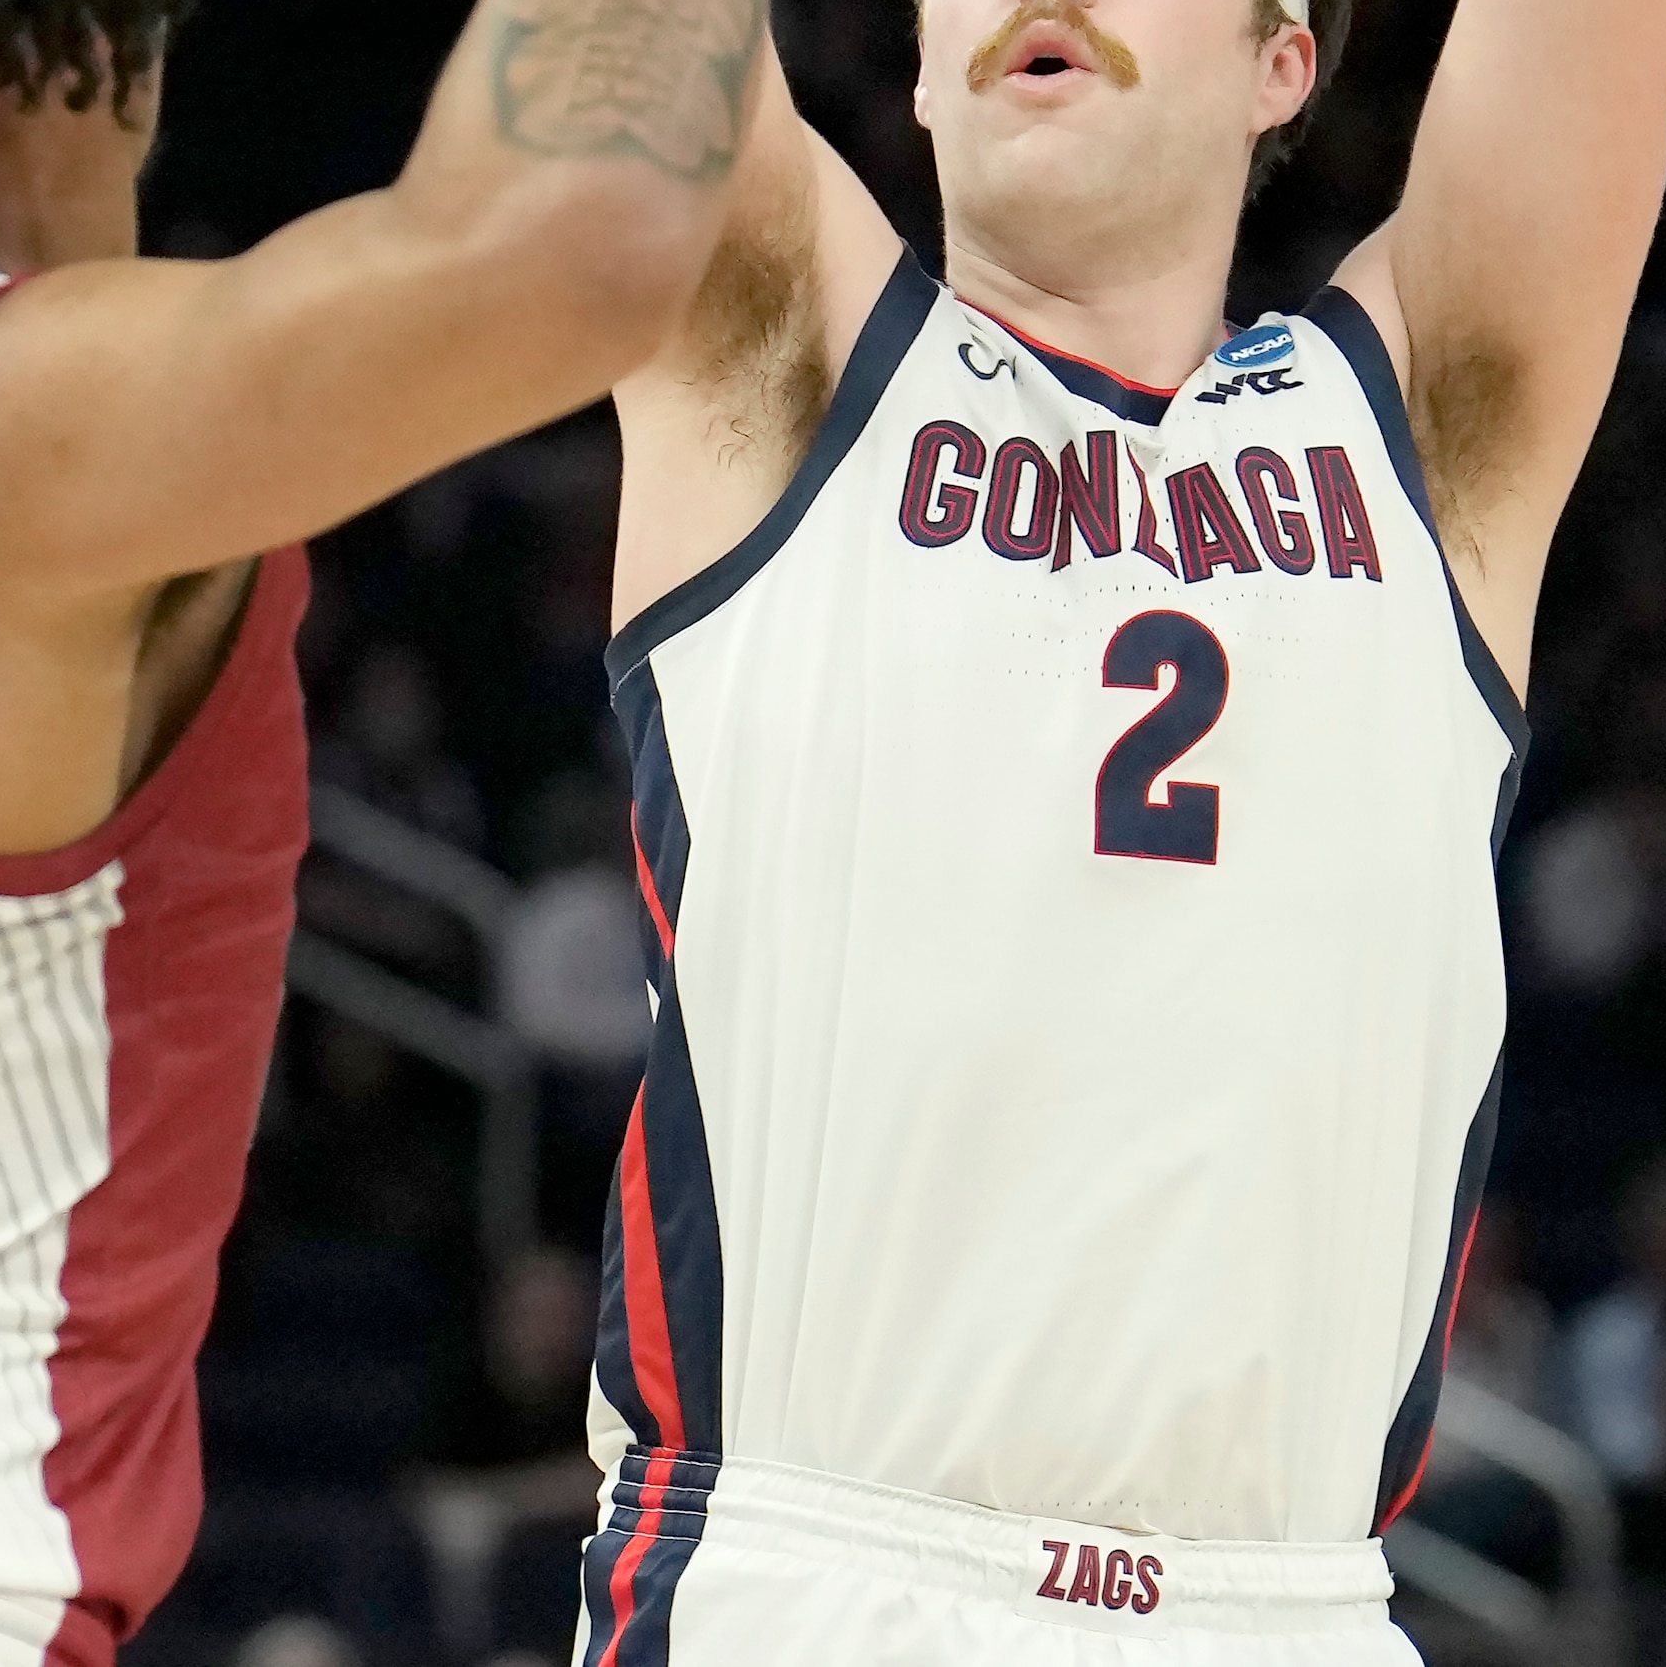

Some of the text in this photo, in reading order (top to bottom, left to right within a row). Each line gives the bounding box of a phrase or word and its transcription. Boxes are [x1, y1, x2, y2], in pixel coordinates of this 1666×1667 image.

[1228, 333, 1294, 362] NCAA
[1094, 609, 1230, 865] 2
[1036, 1540, 1164, 1615] ZAGS
